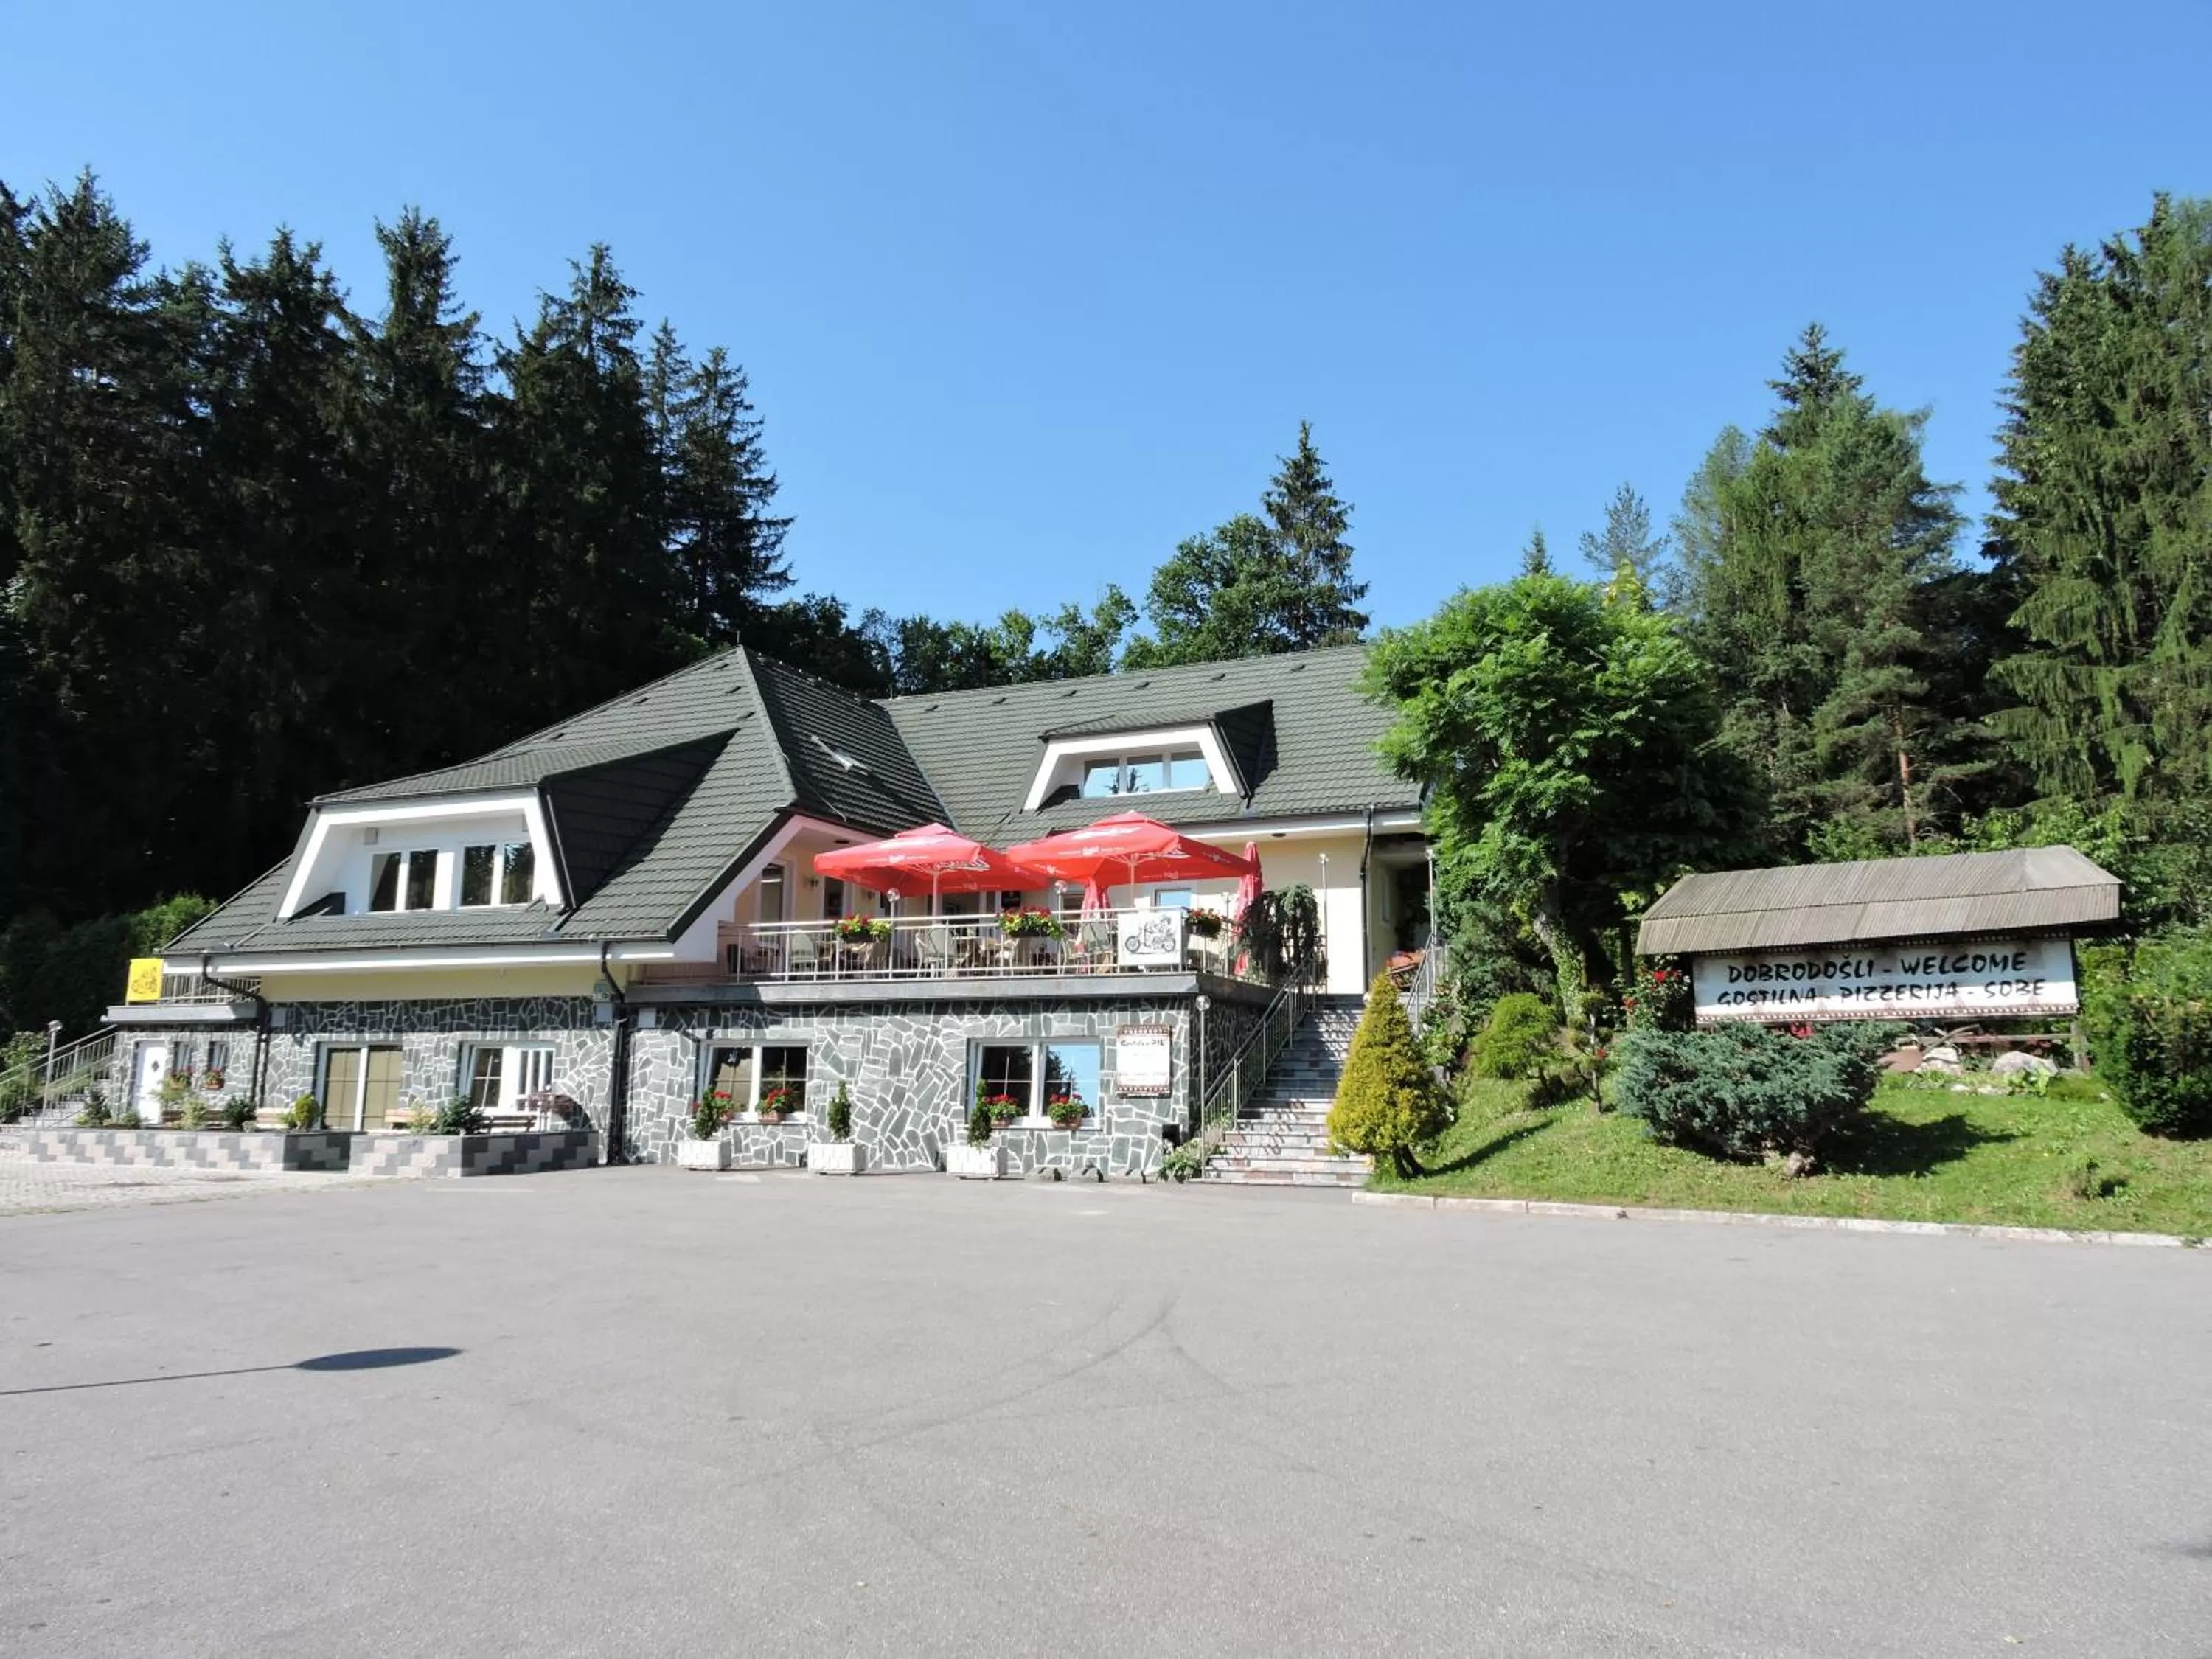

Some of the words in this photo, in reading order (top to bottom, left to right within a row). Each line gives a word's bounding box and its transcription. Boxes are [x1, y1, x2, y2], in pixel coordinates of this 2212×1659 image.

[1728, 954, 1874, 984] DOBRODOŠLI
[1900, 952, 2027, 975] WELCOME
[1717, 987, 1818, 1006] GOSTILNA
[1839, 981, 1959, 1003] PIZZERIJA
[1984, 979, 2047, 998] SOBE
